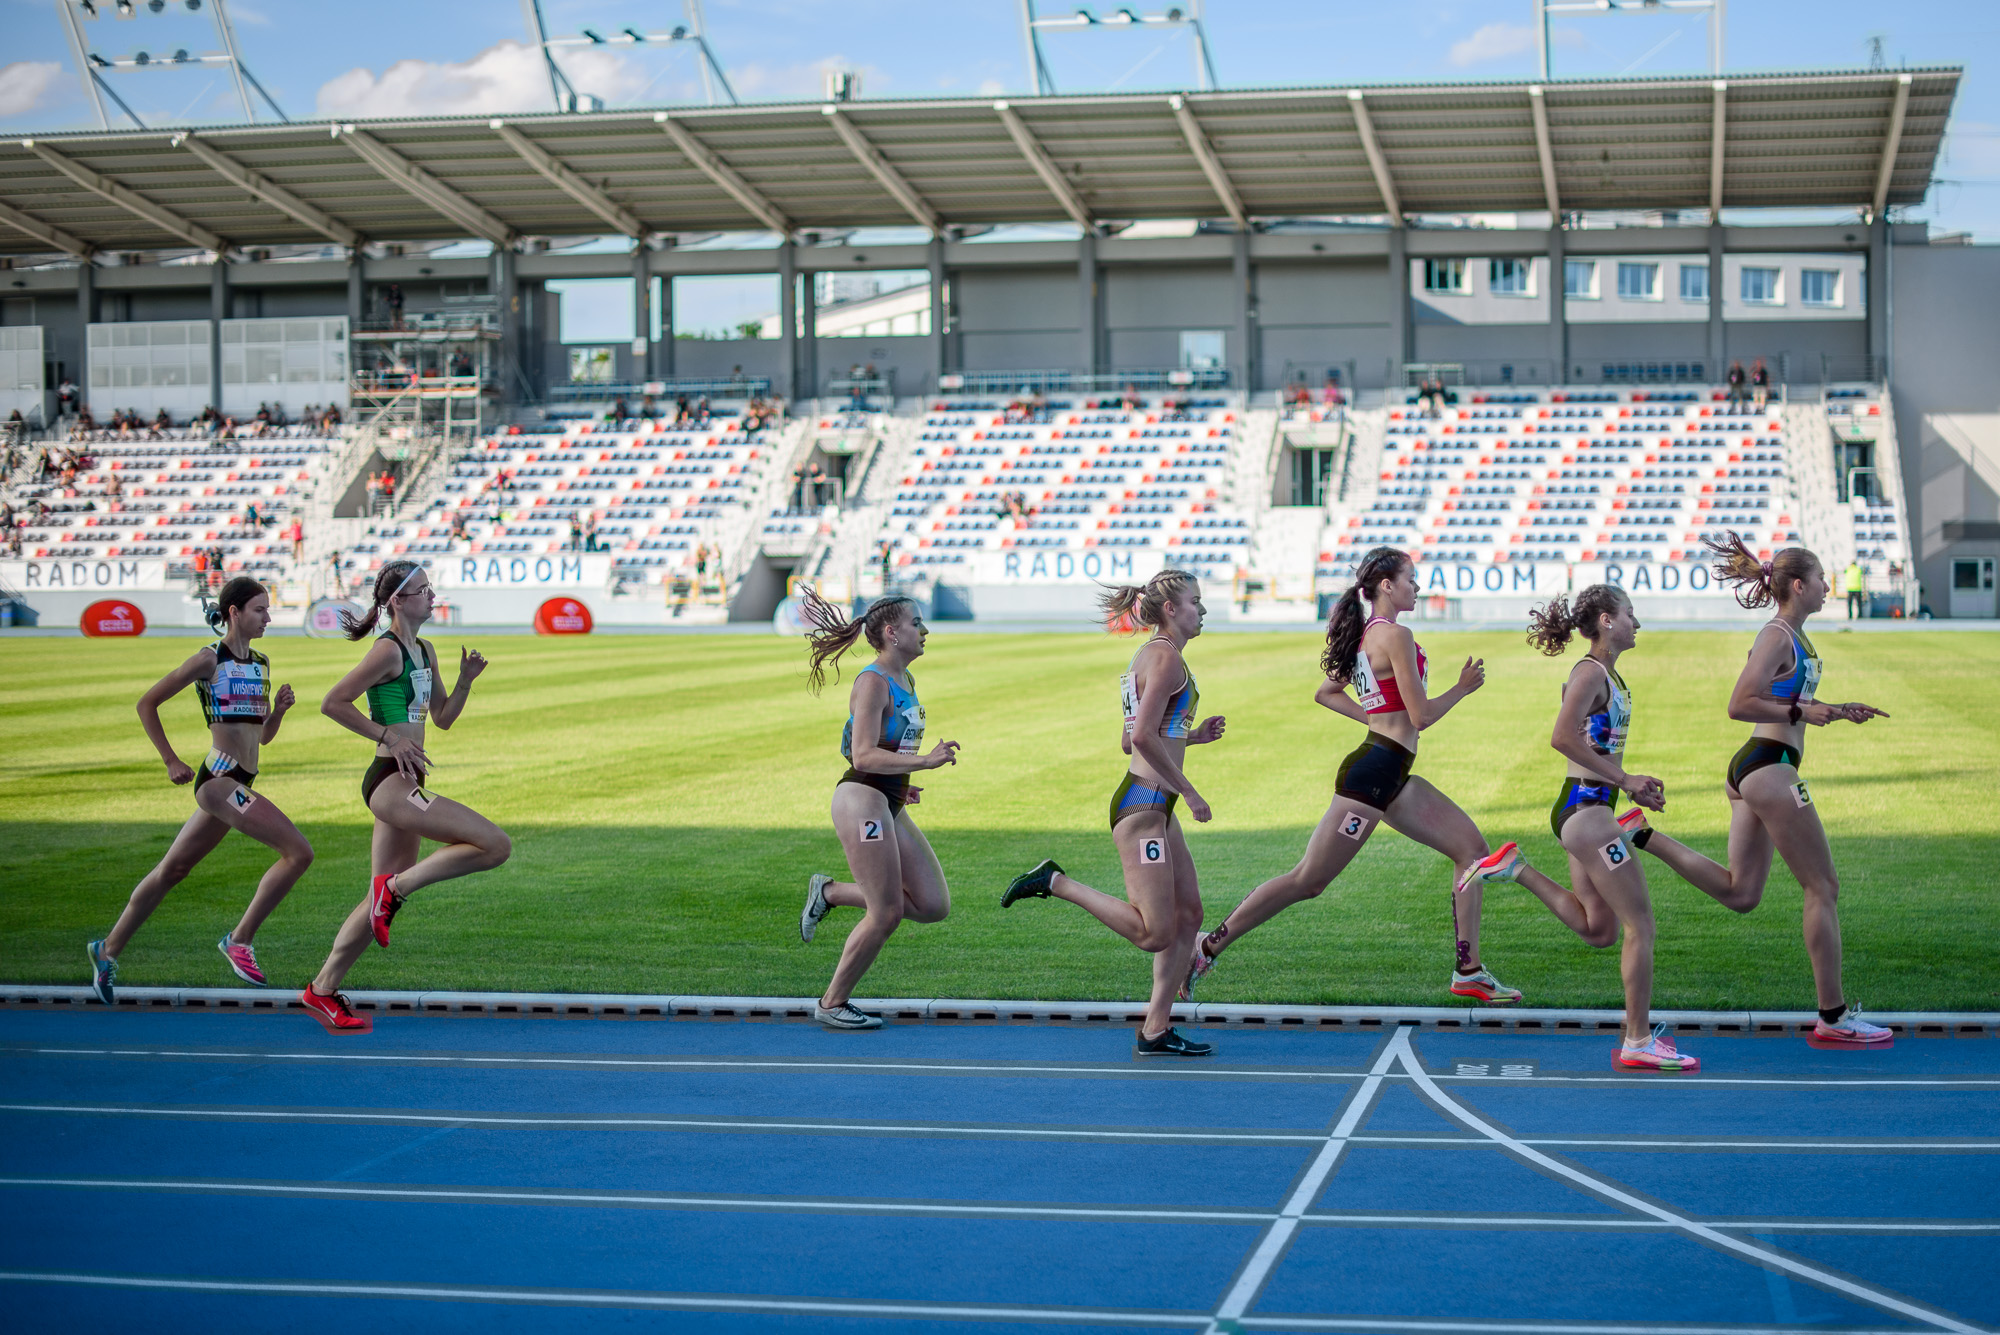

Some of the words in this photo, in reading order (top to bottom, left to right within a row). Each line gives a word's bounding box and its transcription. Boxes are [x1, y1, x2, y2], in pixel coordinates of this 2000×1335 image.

[25, 561, 138, 587] RADOM
[460, 557, 582, 583] RADOM
[1003, 552, 1134, 578] RADOM
[1414, 564, 1536, 592] ADOM
[253, 666, 262, 677] 8
[235, 789, 251, 807] 4
[410, 788, 430, 804] 7
[1796, 783, 1810, 802] 5
[864, 820, 879, 840] 2
[1345, 816, 1362, 836] 3
[1145, 839, 1160, 861] 6
[1605, 843, 1624, 865] 8
